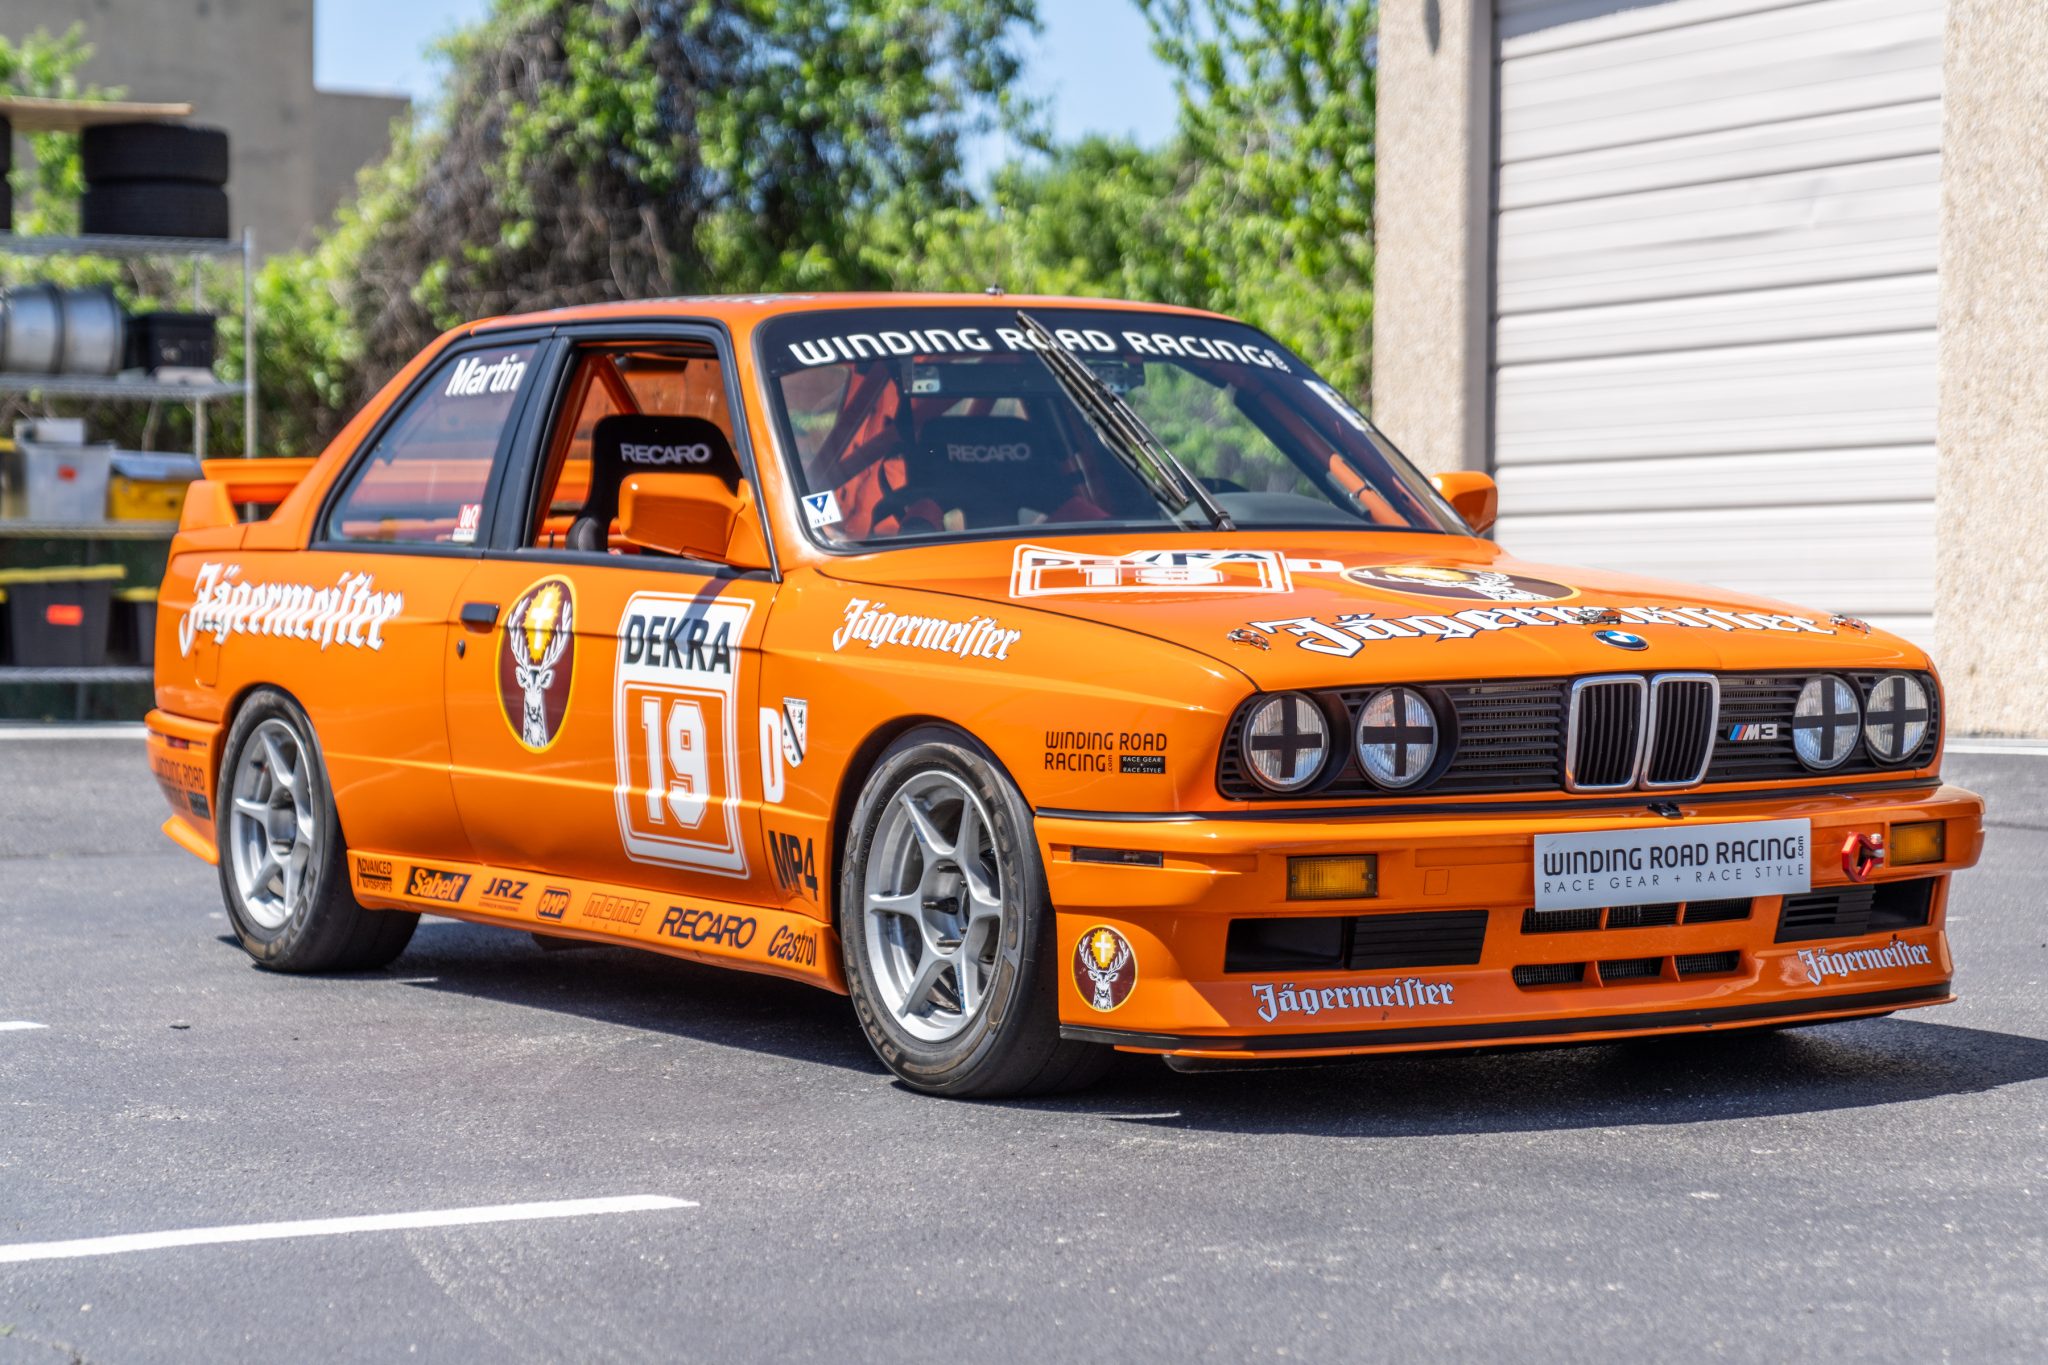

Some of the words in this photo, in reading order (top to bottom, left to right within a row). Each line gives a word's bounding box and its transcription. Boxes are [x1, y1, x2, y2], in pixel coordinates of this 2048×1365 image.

[788, 328, 993, 365] WINDING
[1122, 331, 1274, 368] RACING
[445, 354, 528, 397] Martin
[620, 443, 711, 464] RECARO
[946, 443, 1031, 462] RECARO
[623, 613, 732, 675] DEKRA
[832, 597, 1022, 661] Jägermeister
[1045, 731, 1114, 750] WINDING
[1119, 732, 1168, 751] ROAD
[1743, 723, 1778, 741] M3
[641, 696, 710, 830] 19
[759, 707, 785, 803] D
[1044, 752, 1106, 772] RACING
[768, 830, 819, 902] MP4
[1543, 848, 1642, 876] WINDING
[1650, 844, 1709, 869] ROAD
[1716, 837, 1796, 864] RACING
[483, 877, 529, 900] JRZ
[1544, 878, 1595, 894] RACE
[1610, 875, 1660, 889] GEAR
[1695, 868, 1742, 883] RACE
[1755, 863, 1804, 879] STYLE
[541, 890, 568, 918] OMP
[657, 906, 757, 948] RECARO
[768, 925, 817, 967] Castrol
[1798, 940, 1932, 986] Jägermeister
[1252, 977, 1455, 1023] Jägermeister
